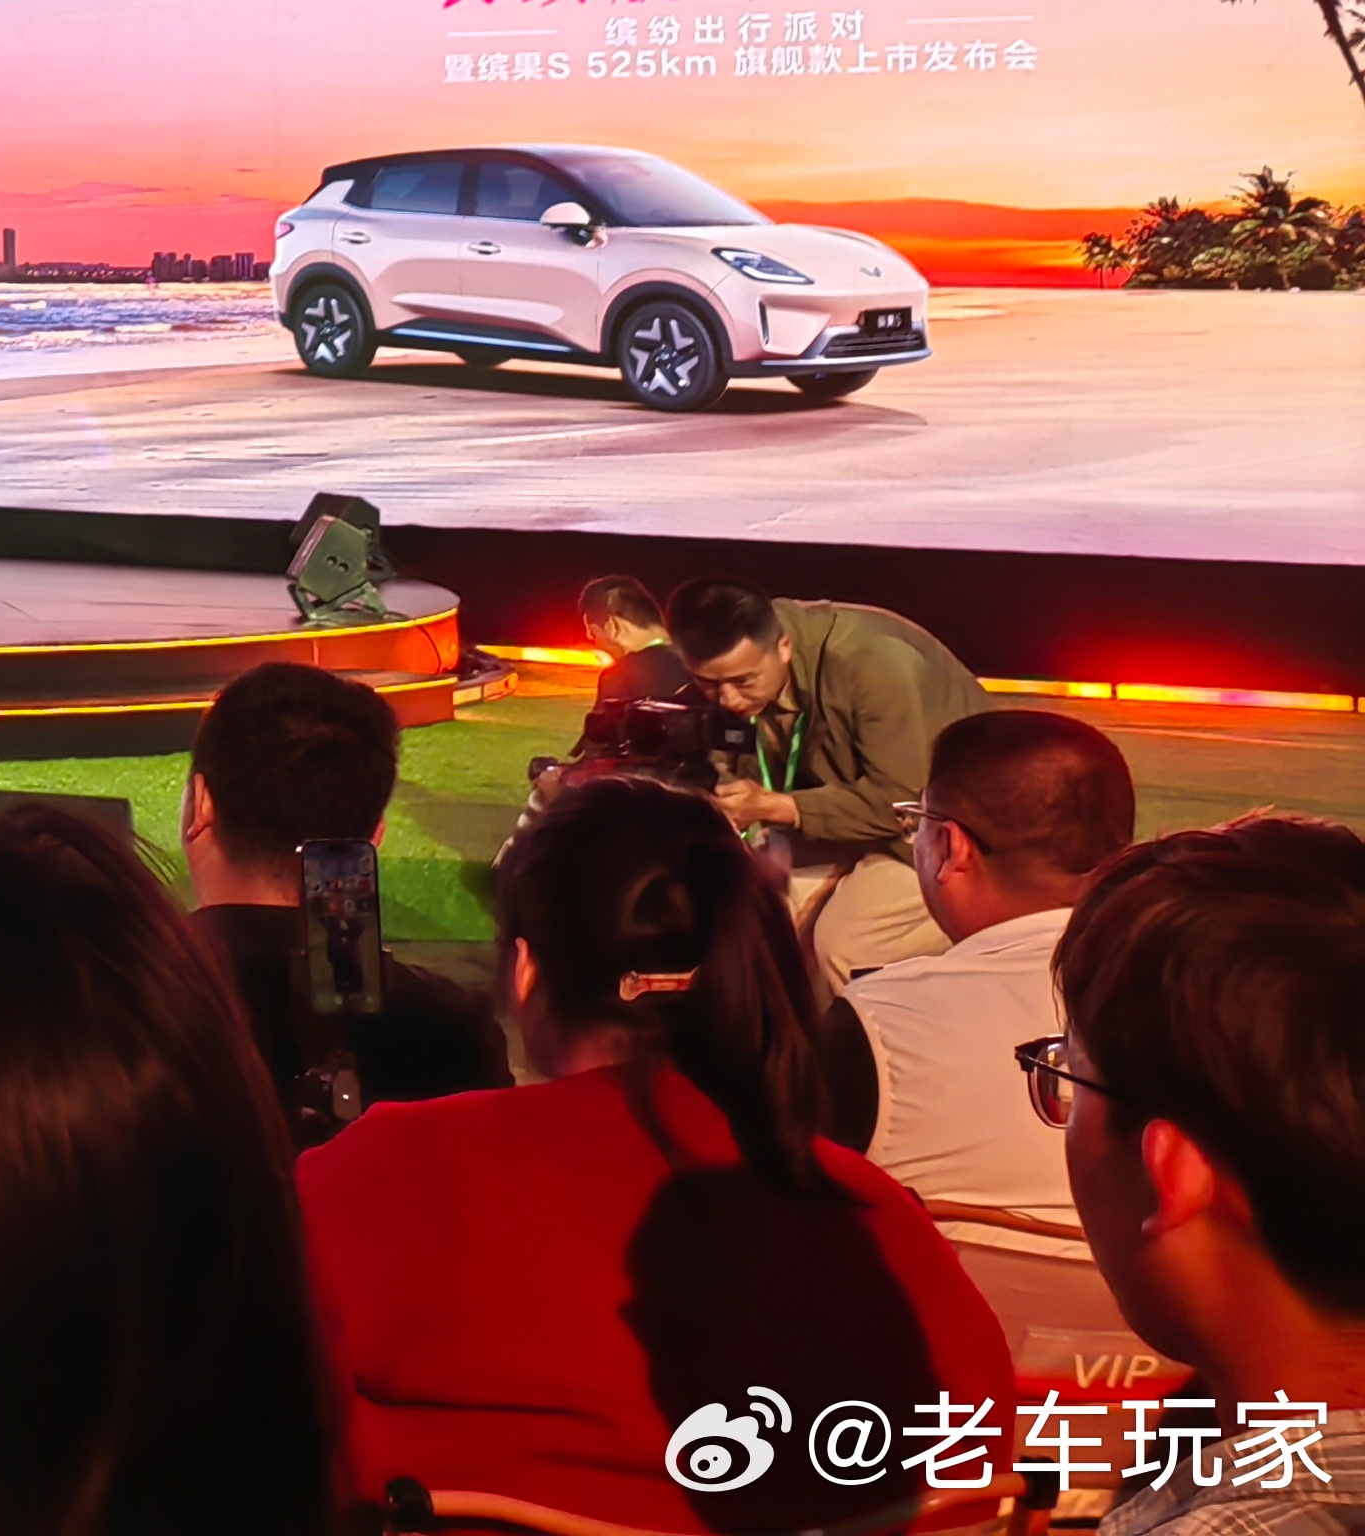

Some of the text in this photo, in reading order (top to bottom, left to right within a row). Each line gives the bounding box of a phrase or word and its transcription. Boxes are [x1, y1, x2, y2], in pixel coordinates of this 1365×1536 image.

[604, 9, 865, 47] 缤纷出行派对
[443, 37, 1039, 83] 暨缤果S 525km 旗舰款上市发布会
[1074, 1353, 1159, 1389] VIP
